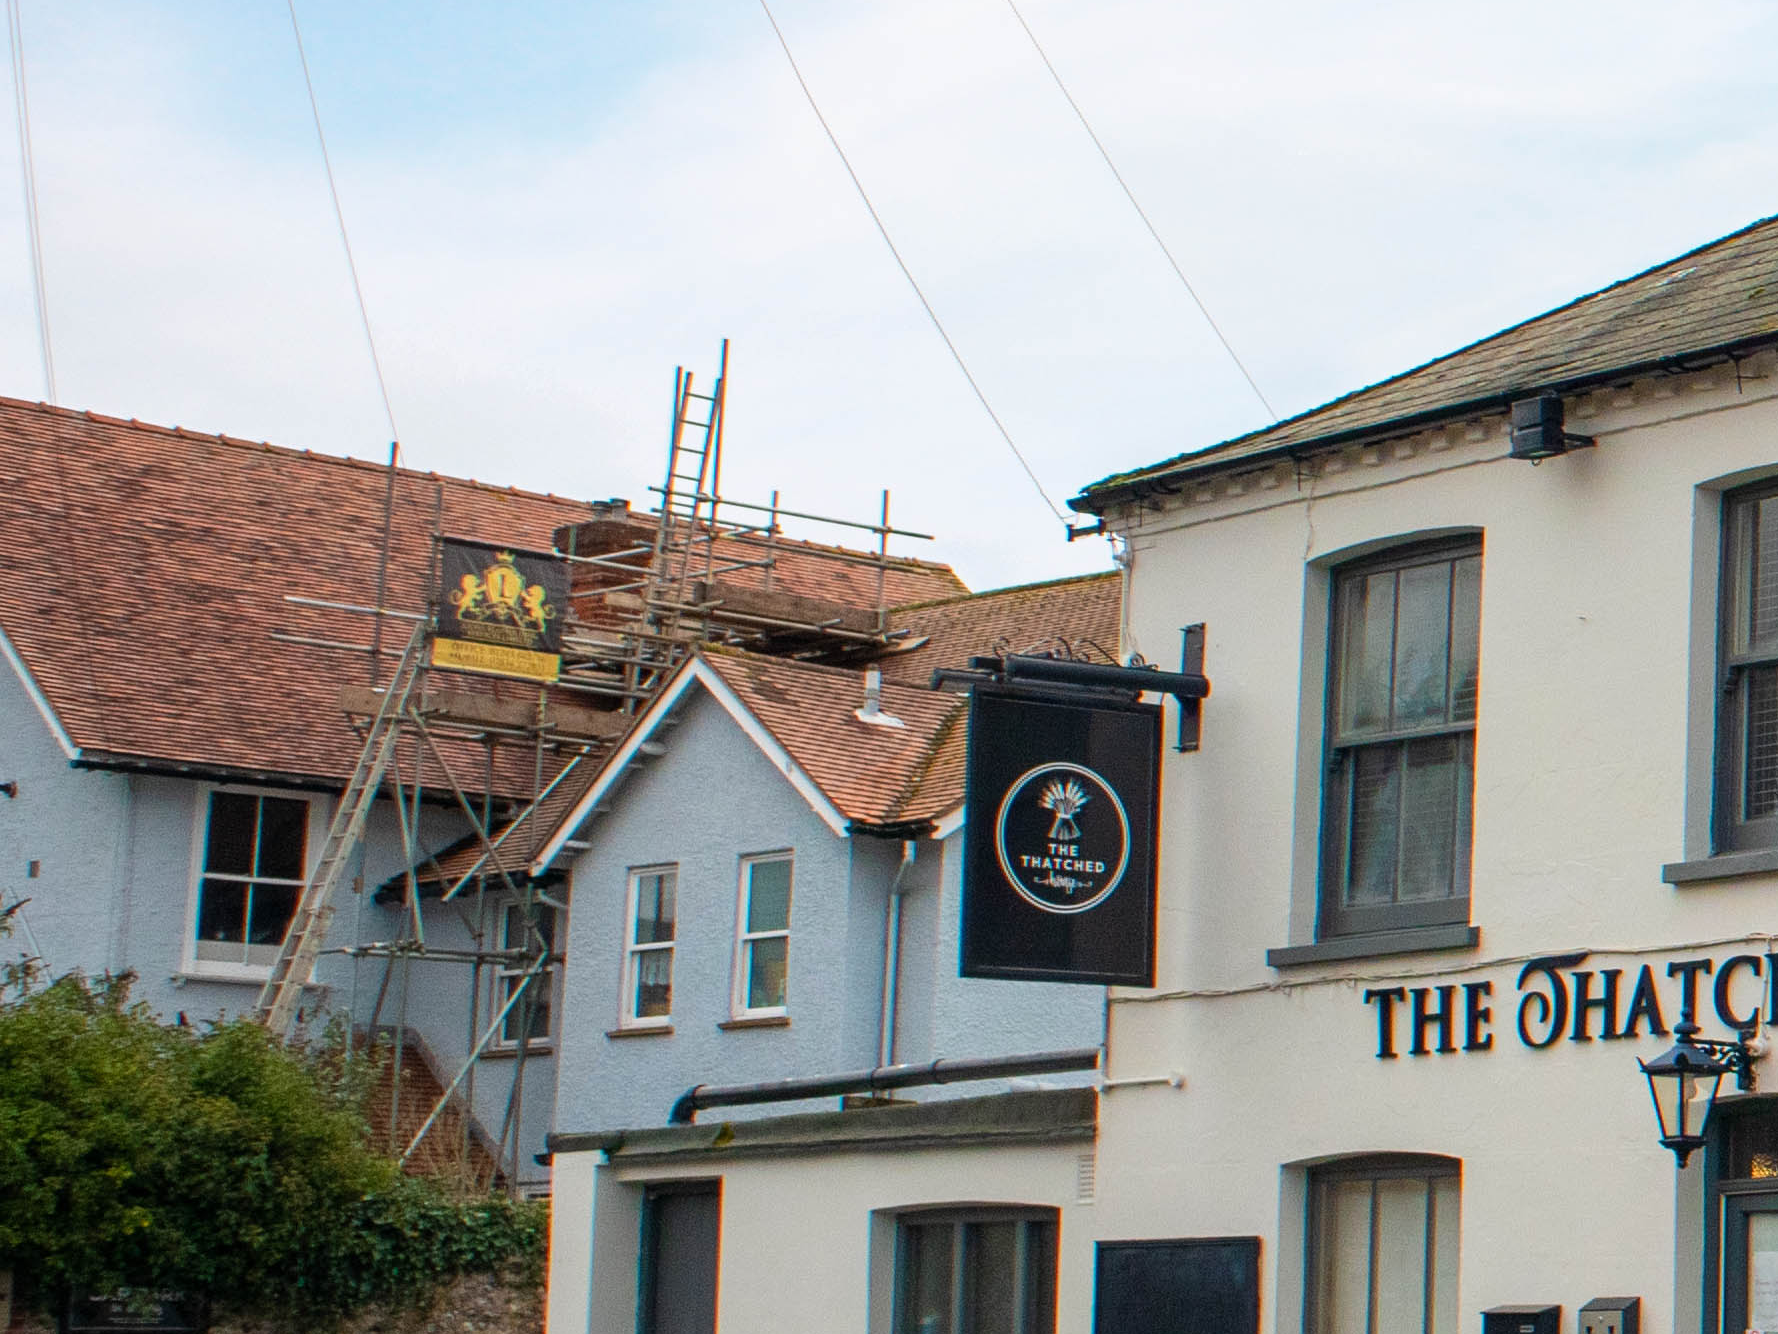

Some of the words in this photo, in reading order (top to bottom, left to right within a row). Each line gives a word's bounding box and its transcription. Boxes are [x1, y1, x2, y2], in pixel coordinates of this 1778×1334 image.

[1048, 843, 1080, 856] THE
[1019, 855, 1106, 873] THATCHED
[1364, 981, 1494, 1059] THE
